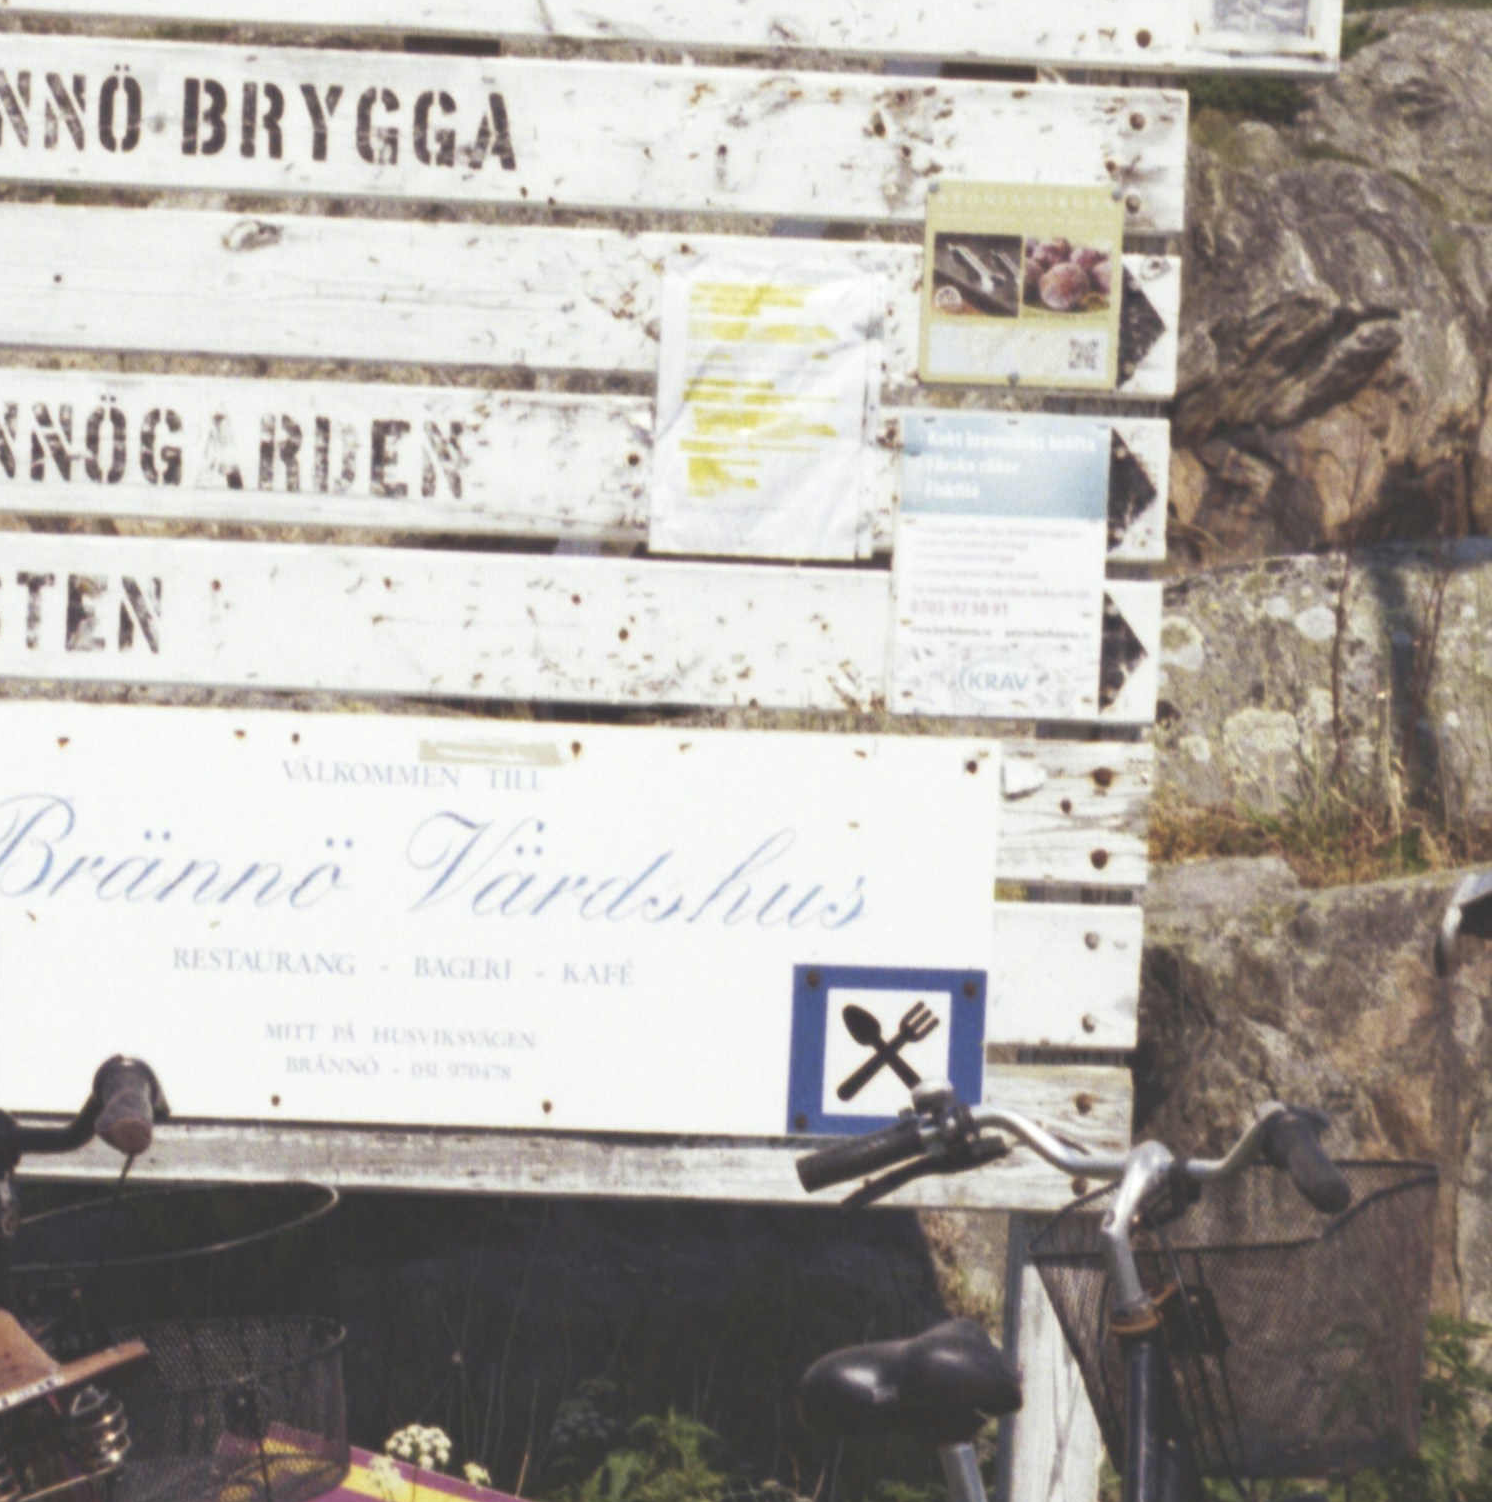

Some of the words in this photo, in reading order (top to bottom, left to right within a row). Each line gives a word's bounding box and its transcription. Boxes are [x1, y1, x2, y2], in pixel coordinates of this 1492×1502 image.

[181, 77, 517, 171] BRYGGA
[968, 672, 1030, 692] KRAV
[281, 755, 461, 789] VÄLKOMMEN
[488, 766, 547, 792] TILL
[407, 810, 866, 930] Värdshus
[173, 946, 356, 977] RESTAURANG
[413, 954, 513, 982] BAGERI
[562, 957, 635, 987] KAFÉ
[265, 1021, 319, 1043] MITT
[332, 1020, 357, 1043] PÅ
[372, 1025, 538, 1050] HUSVIKSVÄGEN
[285, 1053, 380, 1077] BRÄNNÖ
